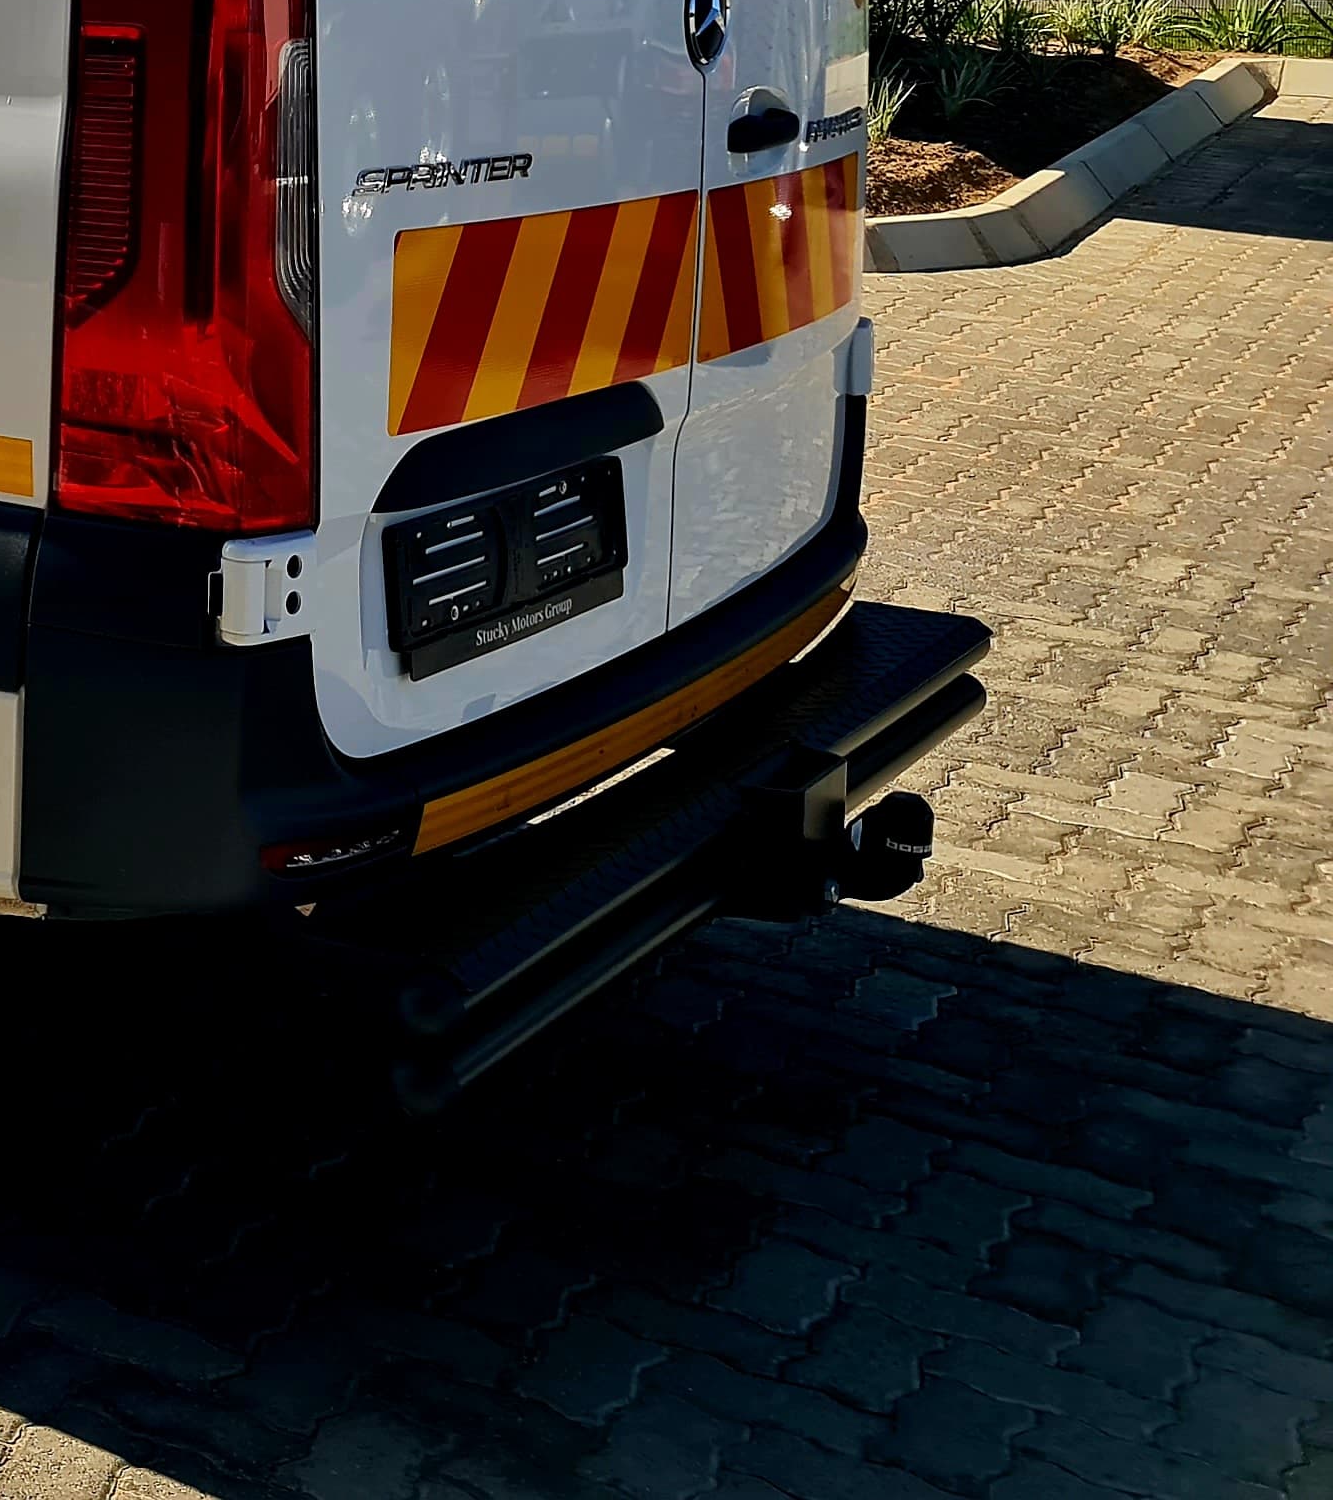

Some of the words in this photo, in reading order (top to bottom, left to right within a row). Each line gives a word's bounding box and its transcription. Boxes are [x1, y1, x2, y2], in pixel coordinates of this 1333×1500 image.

[352, 153, 533, 197] SPRINTER
[476, 621, 510, 646] Stucky
[512, 609, 544, 634] Motors
[545, 598, 573, 619] Group
